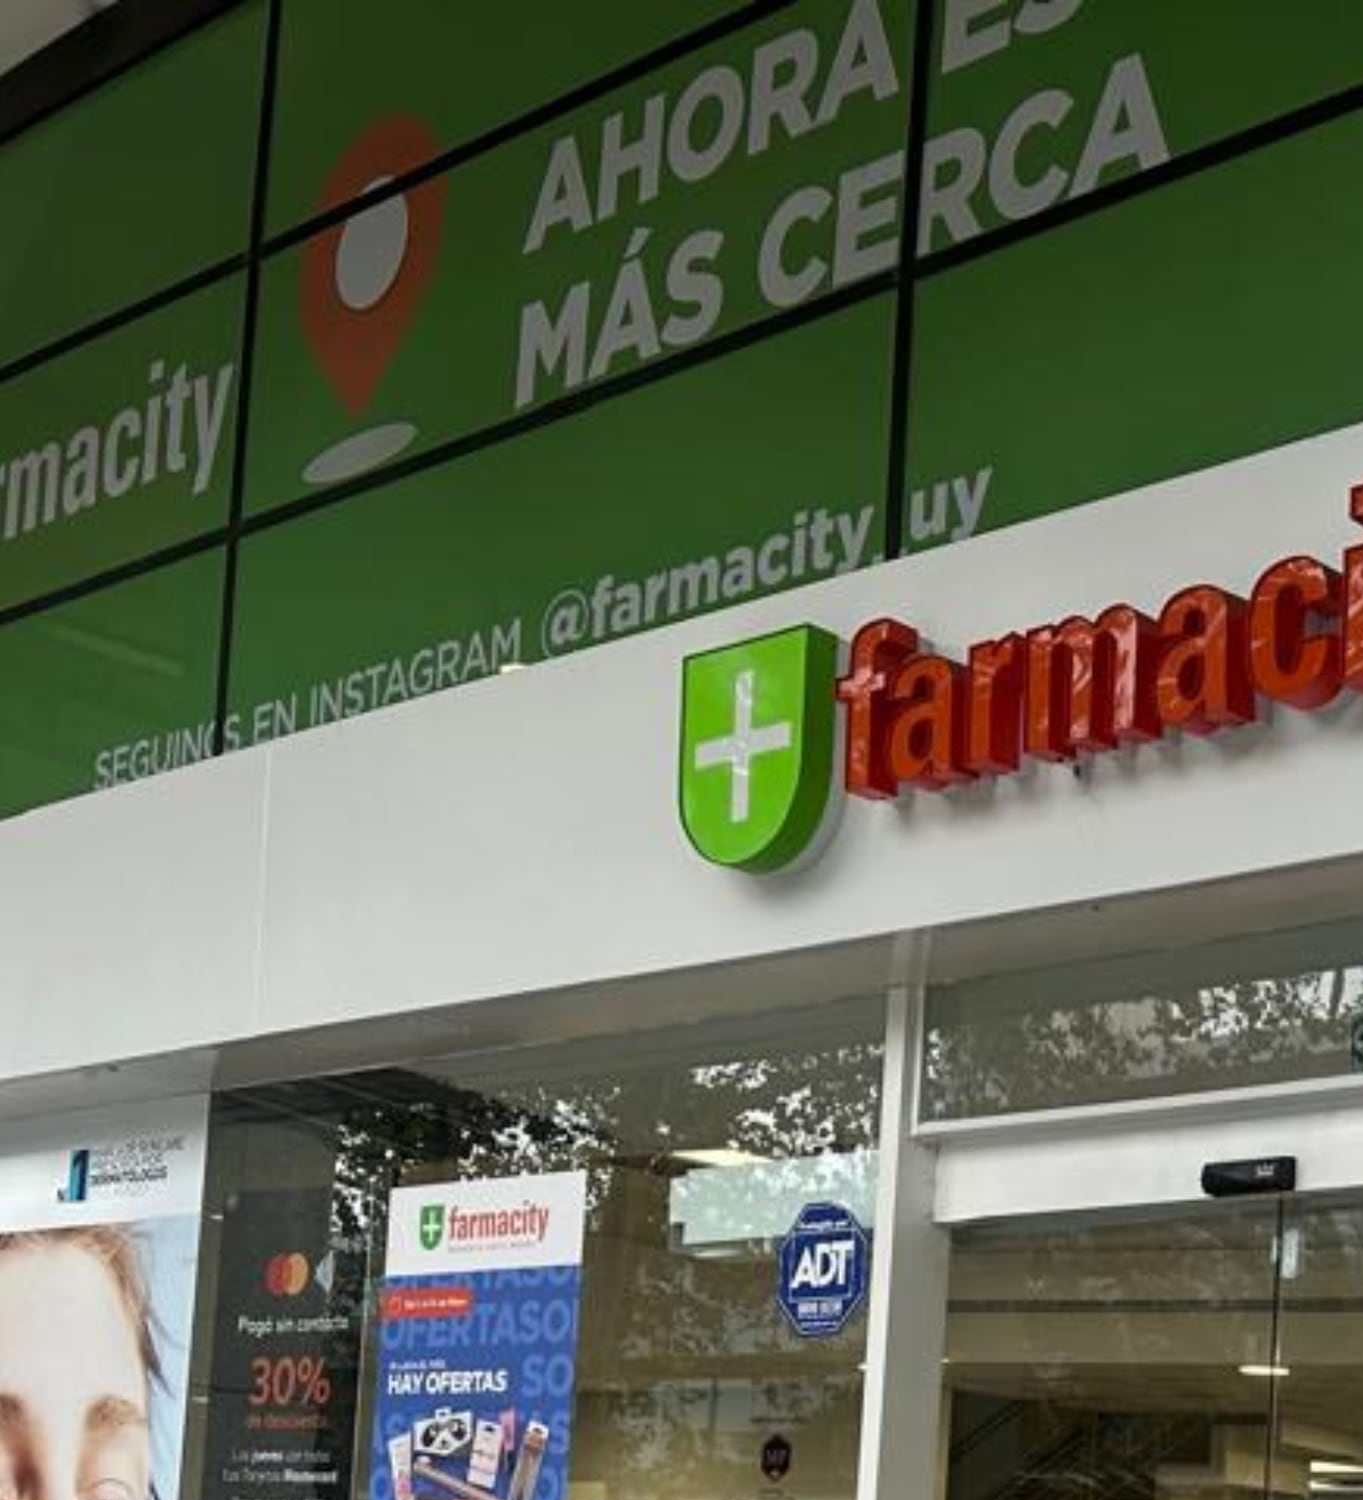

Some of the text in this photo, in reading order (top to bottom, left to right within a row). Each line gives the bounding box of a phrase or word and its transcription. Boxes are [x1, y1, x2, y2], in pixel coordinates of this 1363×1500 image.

[523, 0, 898, 253] AHORA
[516, 53, 1170, 409] MÁS CERCA
[252, 699, 297, 745] EN
[309, 619, 521, 725] INSTAGRAM
[448, 1201, 549, 1241] farmacity
[789, 1240, 855, 1288] ADT
[249, 1355, 331, 1406] 30%
[388, 1368, 508, 1395] HAY OFERTAS
